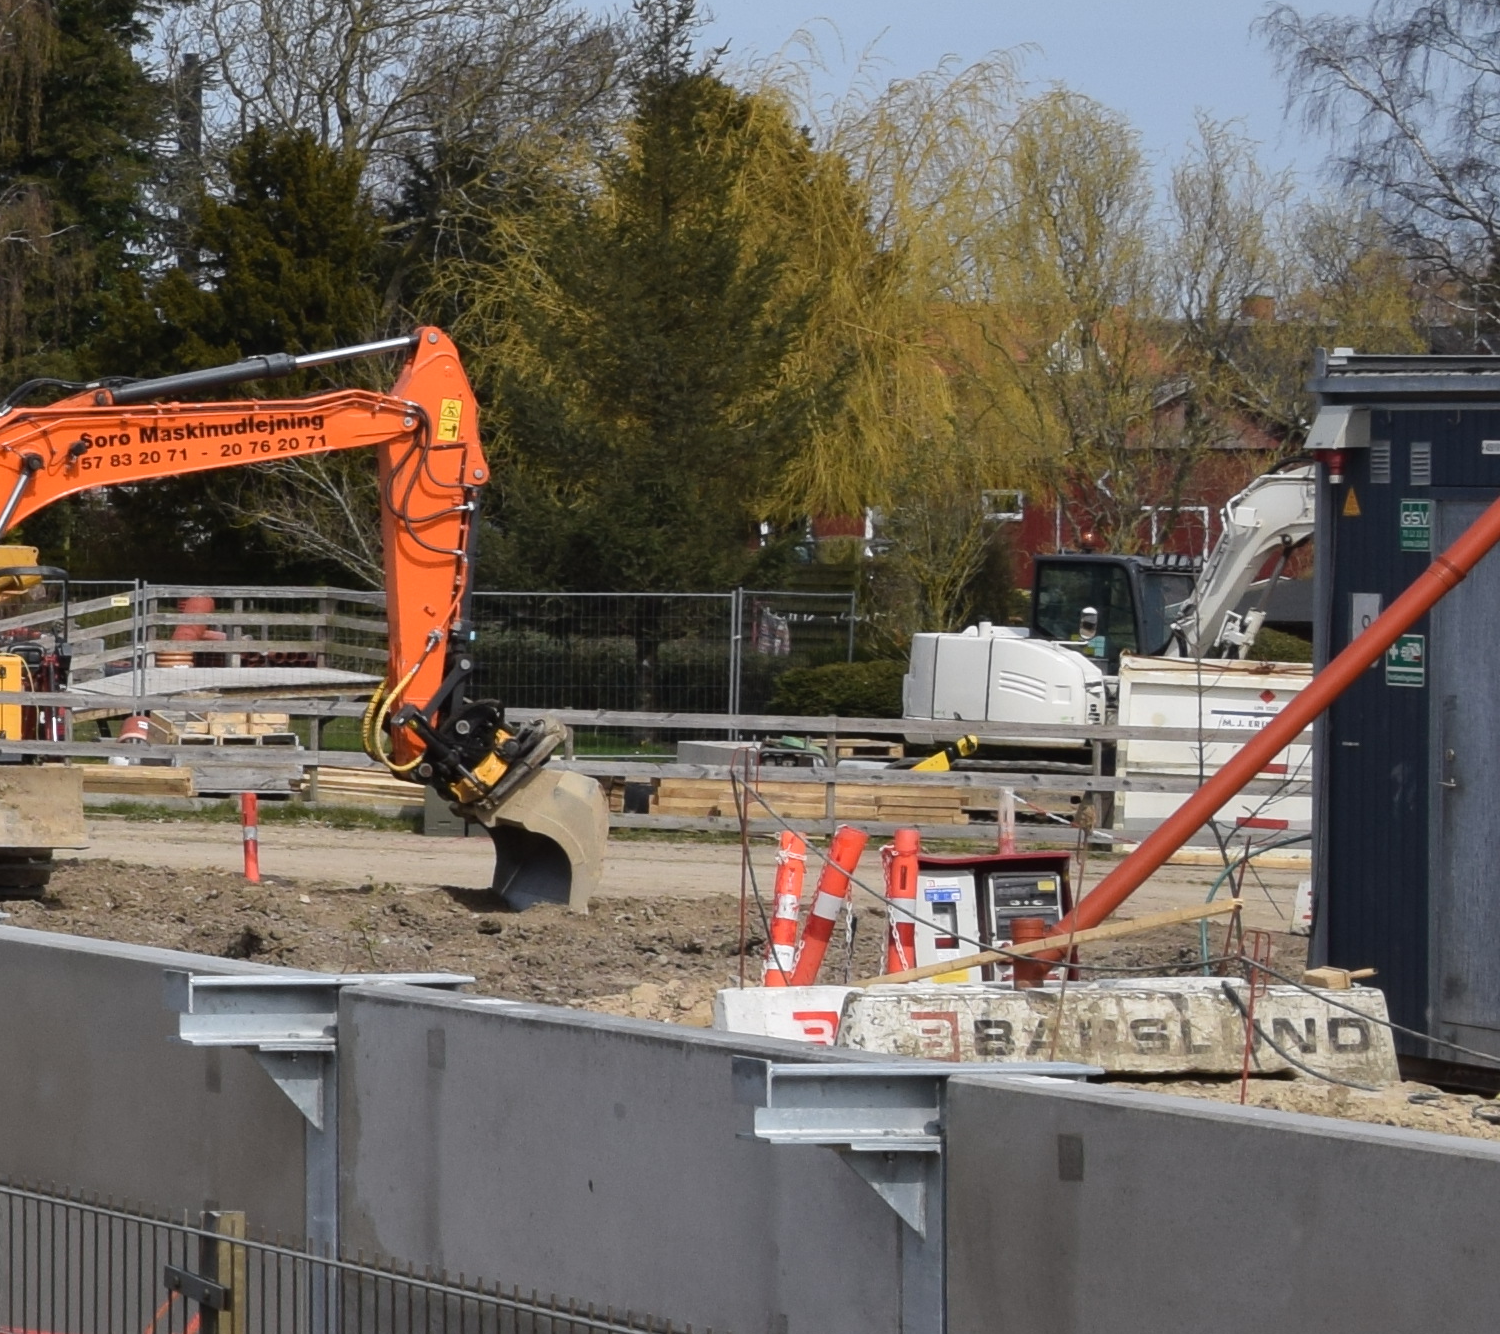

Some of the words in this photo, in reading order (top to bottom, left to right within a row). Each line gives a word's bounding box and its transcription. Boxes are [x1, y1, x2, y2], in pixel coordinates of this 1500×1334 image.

[80, 433, 131, 449] Sorø
[139, 415, 325, 444] Maskinudlejning
[81, 456, 102, 470] 57
[110, 454, 132, 467] 83
[139, 451, 161, 464] 20
[168, 448, 187, 461] 71
[220, 443, 242, 457] 20
[250, 440, 271, 453] 76
[277, 437, 299, 451] 20
[306, 435, 327, 448] 71
[1402, 511, 1429, 525] GSV
[973, 1017, 1372, 1057] BASLUND
